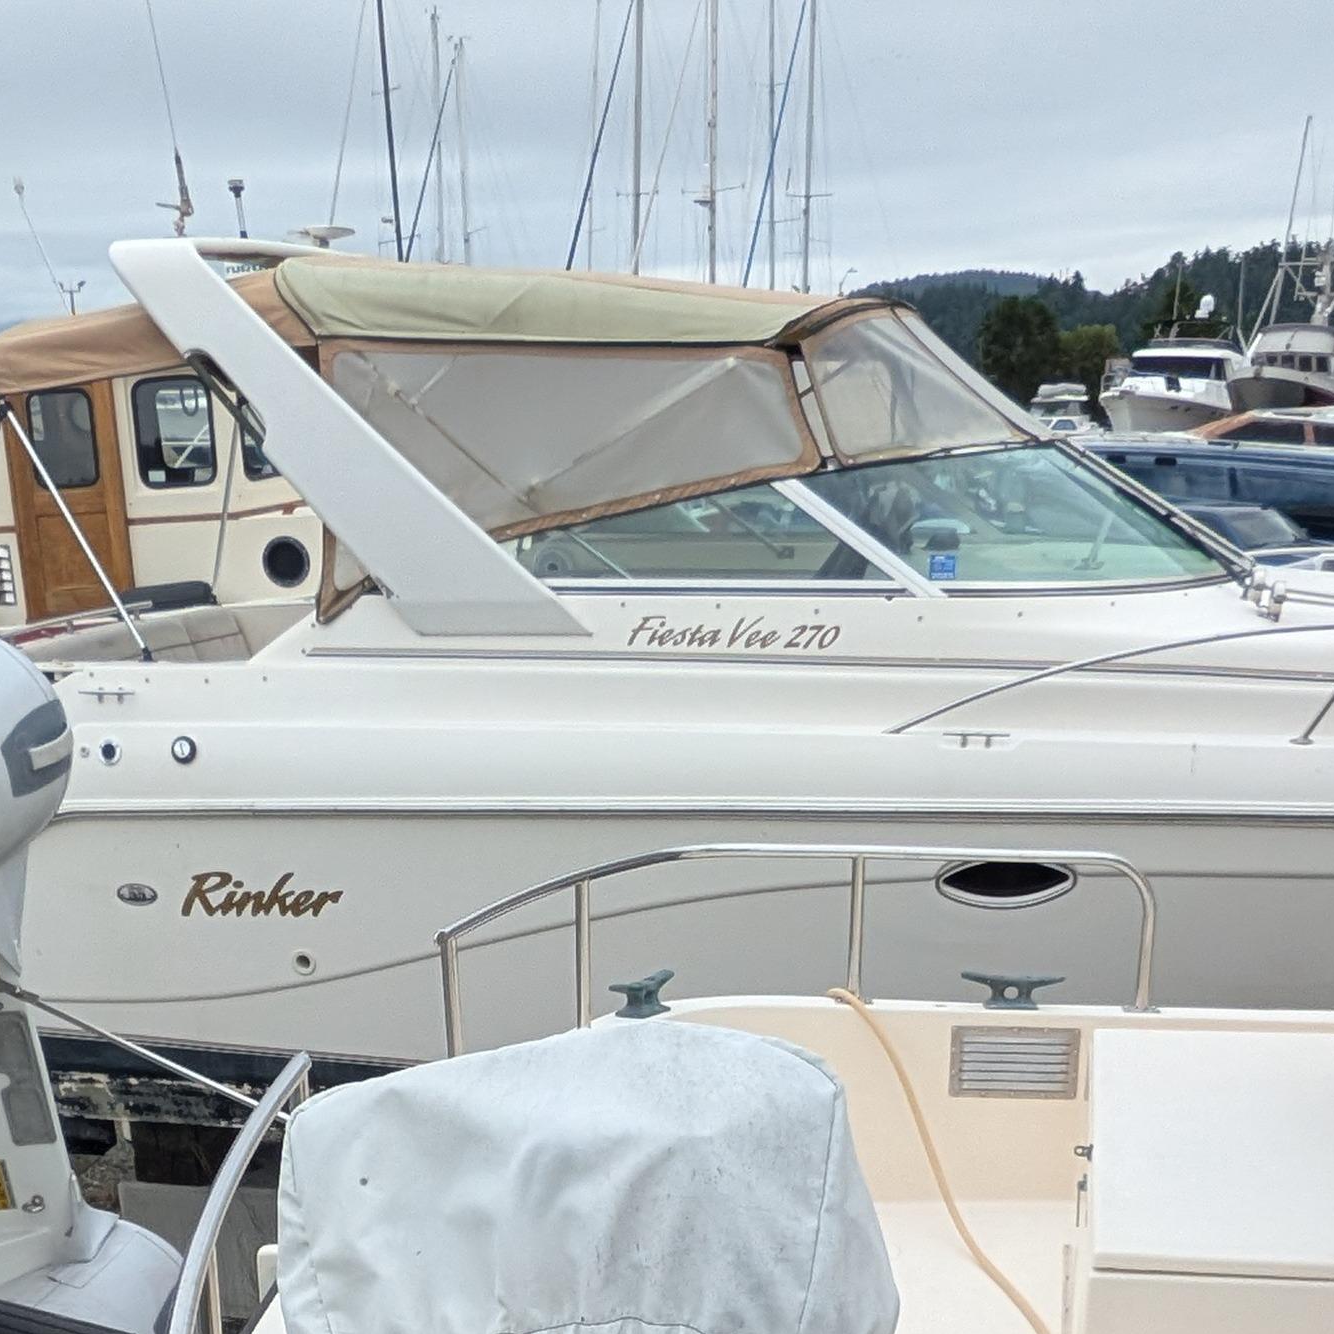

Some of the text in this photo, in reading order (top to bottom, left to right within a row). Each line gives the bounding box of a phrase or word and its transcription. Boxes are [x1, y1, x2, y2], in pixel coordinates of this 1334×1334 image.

[627, 615, 841, 650] Fiesta Vee 270
[180, 870, 345, 918] Rinker
